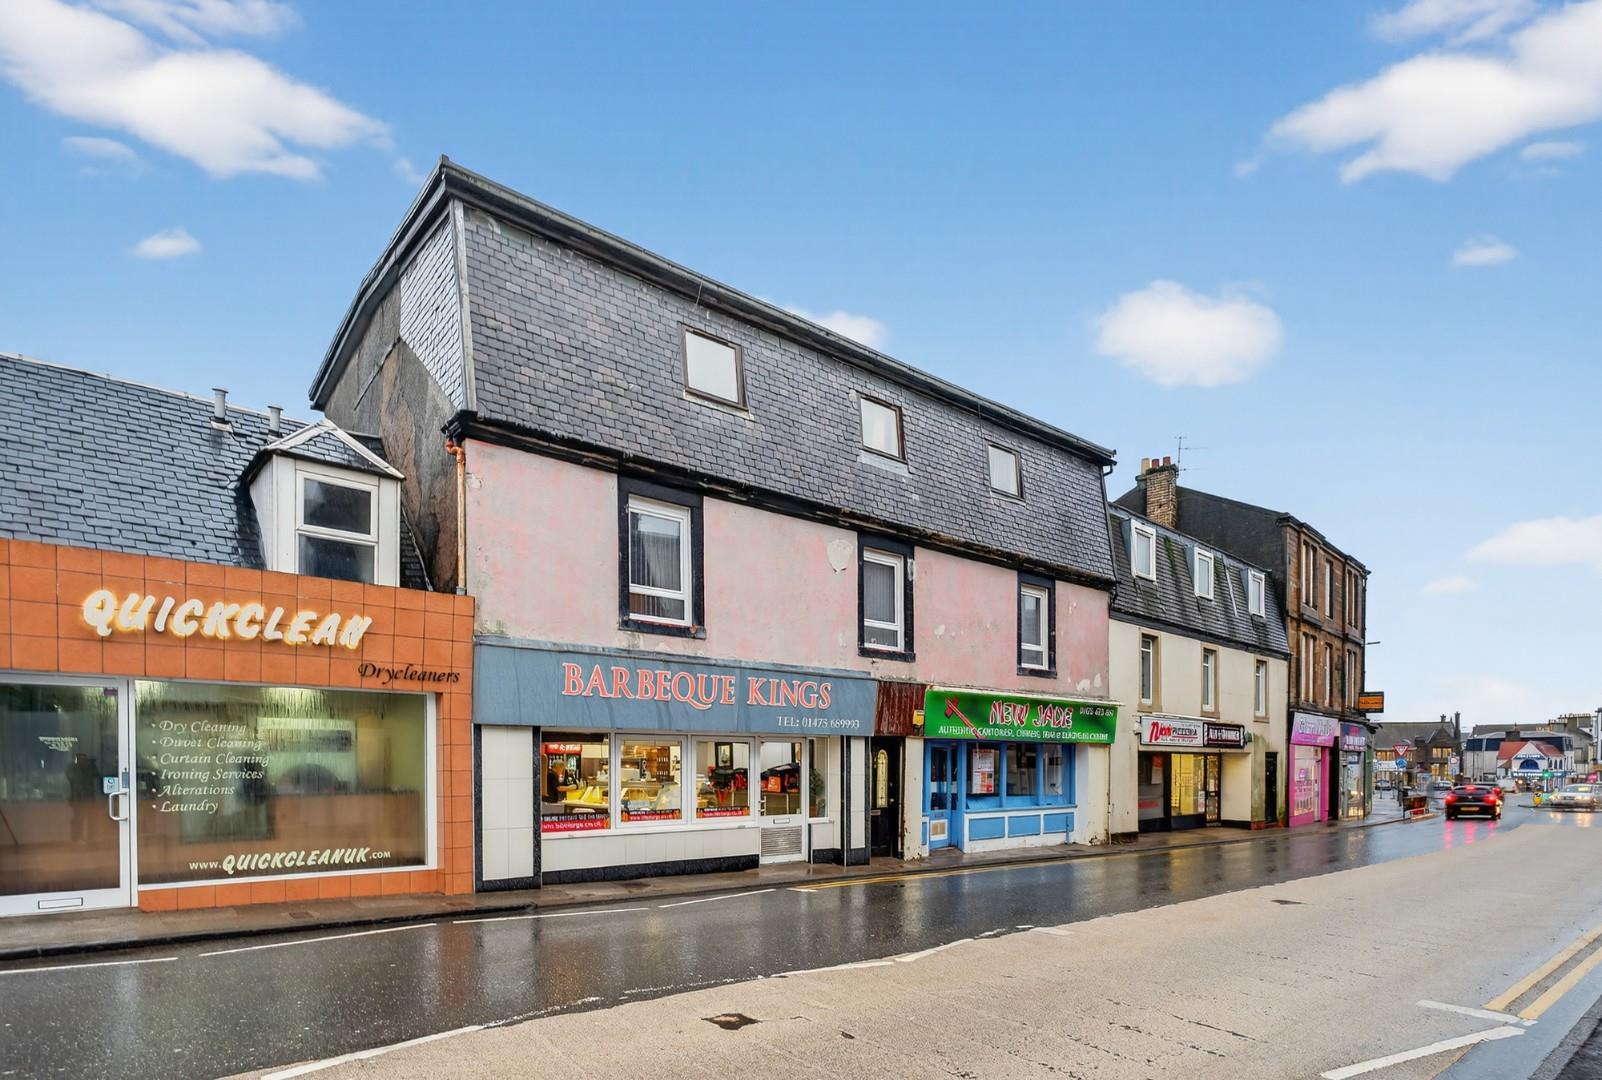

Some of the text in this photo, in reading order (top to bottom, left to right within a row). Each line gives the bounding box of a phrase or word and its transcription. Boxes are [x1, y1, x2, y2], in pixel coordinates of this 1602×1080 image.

[82, 589, 373, 649] QUICKCLEAN
[358, 662, 460, 685] Drycleaners
[562, 661, 832, 710] BARBEQUE KINGS
[989, 699, 1074, 729] NEW JADE
[159, 720, 247, 735] Dry Cleaning
[776, 716, 800, 727] TEL:
[801, 716, 828, 728] 01475
[159, 736, 261, 751] Duvet Cleaning
[160, 752, 271, 767] Curtain Cleaning
[160, 769, 265, 783] Ironing Services
[157, 784, 235, 797] Alterations
[160, 799, 219, 814] Laundry
